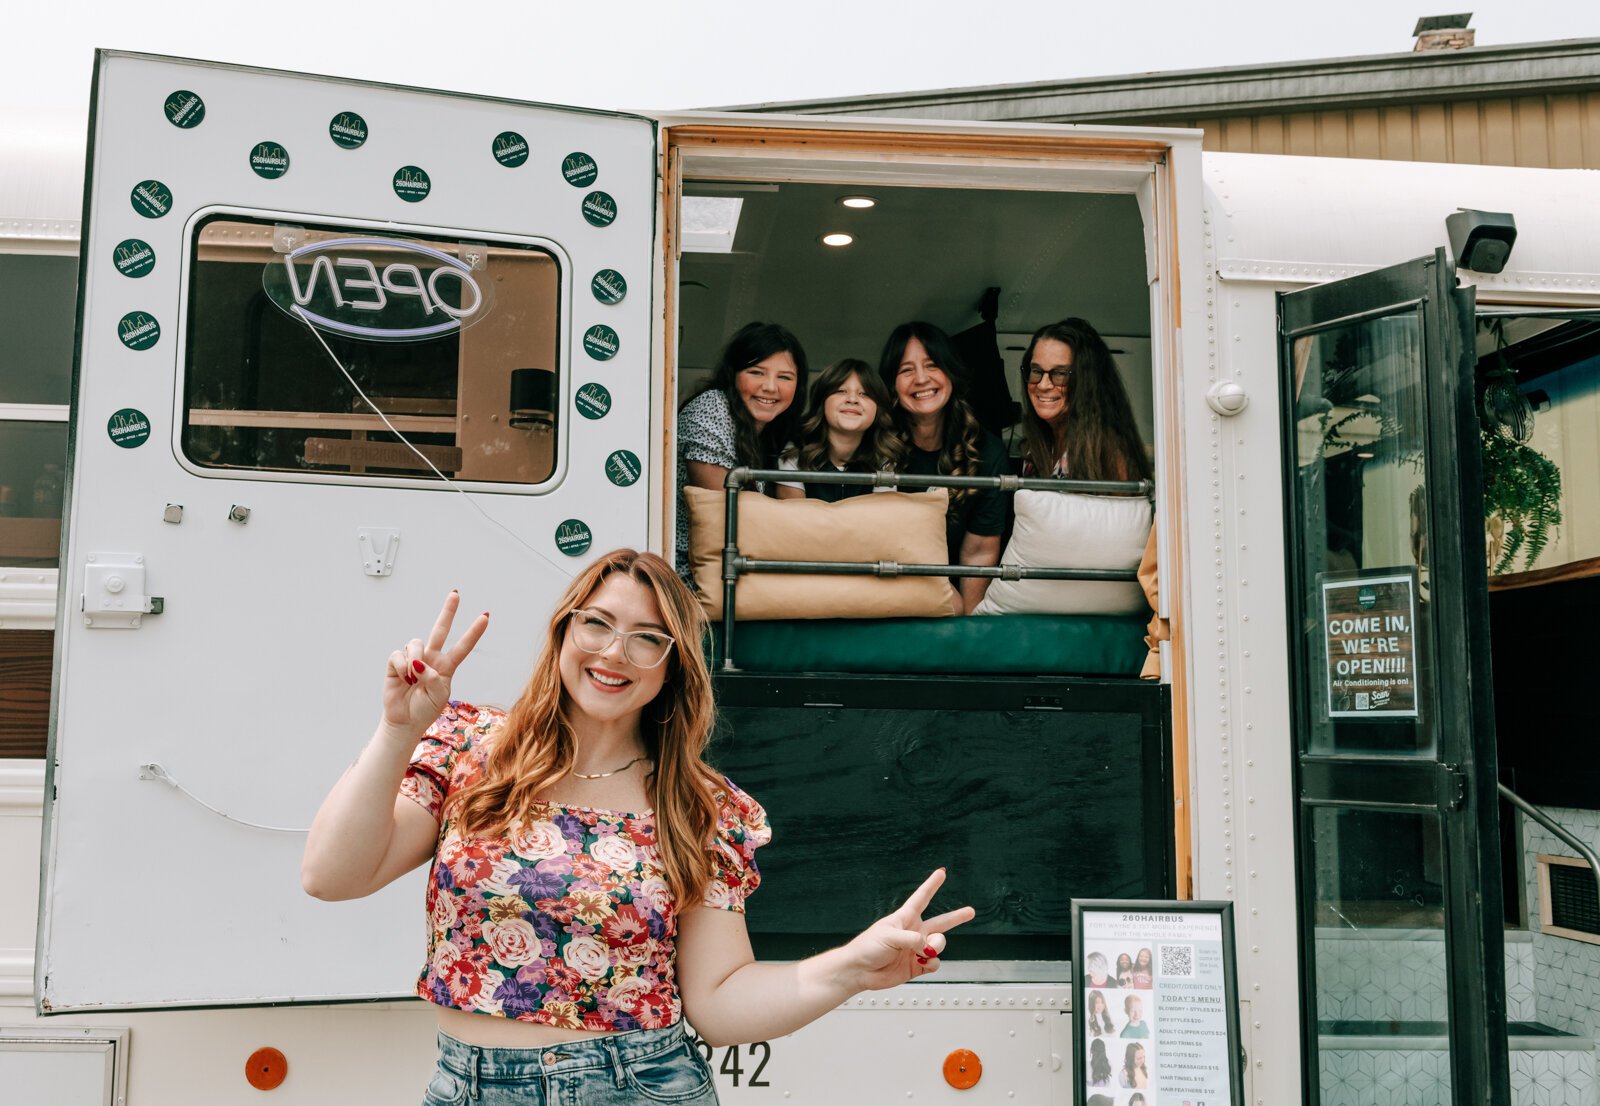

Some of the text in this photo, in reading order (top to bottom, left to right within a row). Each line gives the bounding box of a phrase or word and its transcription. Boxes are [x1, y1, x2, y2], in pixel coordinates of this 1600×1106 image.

[173, 97, 198, 123] 260HAIRBUS
[332, 124, 364, 138] 260HAIRBUS
[496, 144, 526, 157] 260HAIRBUS
[253, 157, 286, 166] 260HAIRBUS
[566, 164, 594, 177] 260HAIRBUS
[396, 181, 427, 189] 260HAIRBUS
[136, 187, 166, 212] 260HAIRBUS
[584, 201, 613, 218] 260HAIRBUS
[118, 249, 151, 268] 260HAIRBUS
[596, 276, 623, 298] 260HAIRBUS
[123, 322, 157, 341] 260HAIRBUS
[586, 335, 616, 352] 260HAIRBUS
[579, 392, 607, 412] 260HAIRBUS
[111, 422, 147, 435] 260HAIRBUS
[612, 454, 635, 482] 260HAIRBUS
[558, 532, 589, 545] 260HAIRBUS
[1330, 616, 1409, 635] COME IN,
[1342, 637, 1399, 655] WE'RE
[1337, 657, 1406, 675] OPEN!!!!
[1344, 679, 1389, 687] Conditioning
[1371, 691, 1390, 701] Scan
[1122, 914, 1184, 923] 260HAIRBUS
